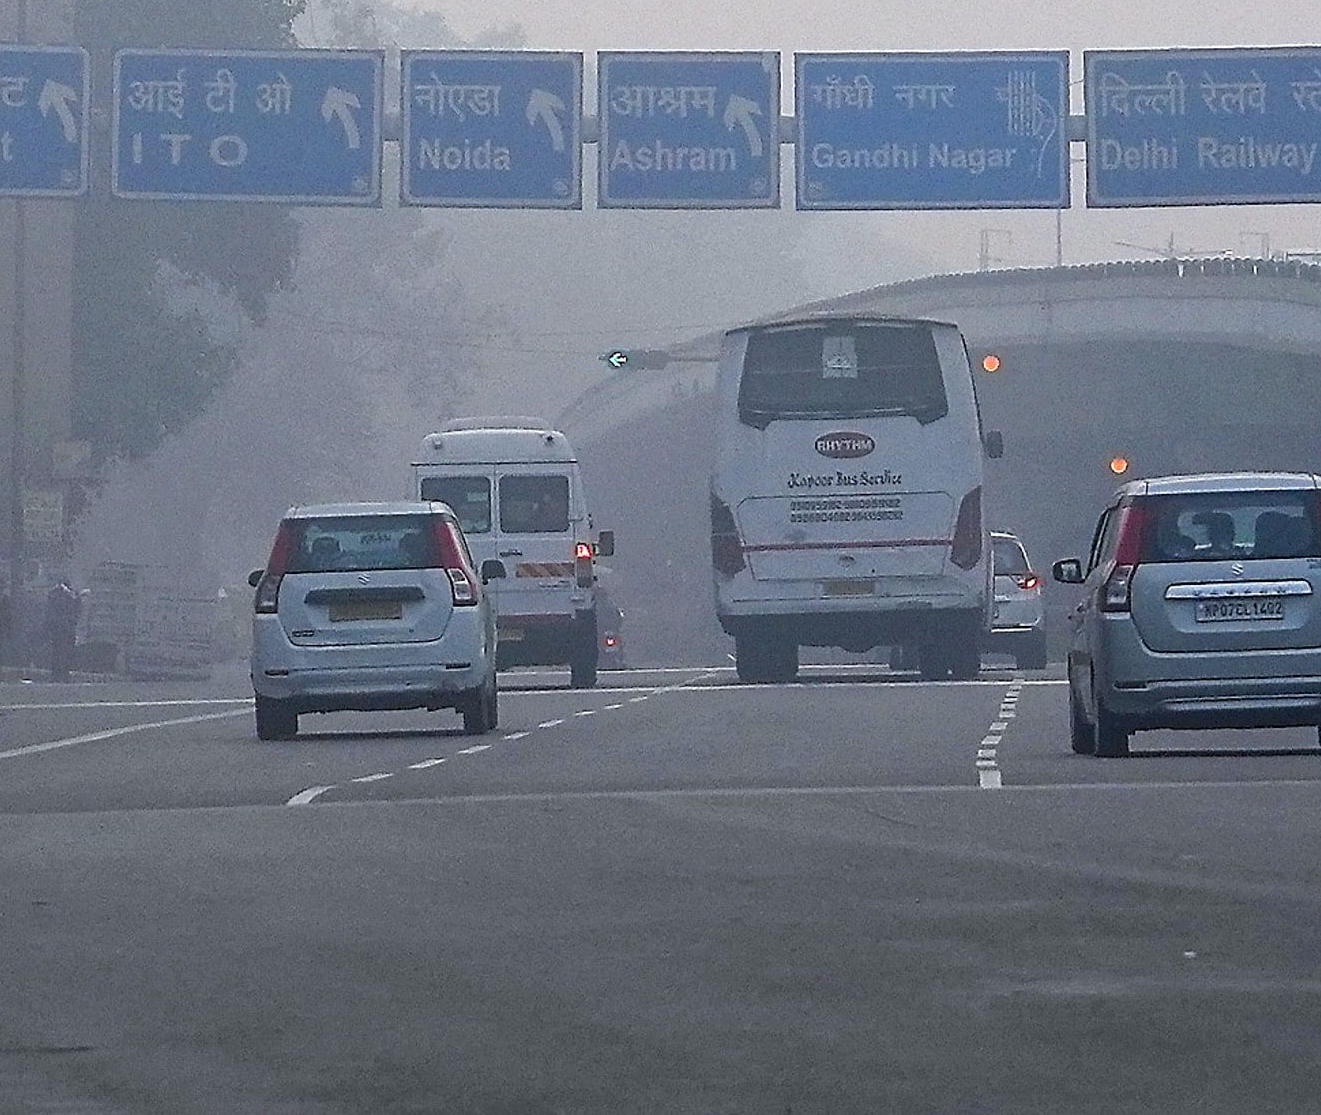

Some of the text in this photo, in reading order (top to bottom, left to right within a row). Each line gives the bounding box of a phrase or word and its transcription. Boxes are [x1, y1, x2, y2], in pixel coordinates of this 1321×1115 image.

[413, 69, 502, 123] नोएडा
[610, 85, 719, 118] आश्रम
[892, 84, 957, 110] नगर
[1098, 70, 1187, 118] दिल्ली
[1200, 68, 1268, 115] रेलवे
[418, 138, 512, 171] Noida
[610, 139, 737, 171] Ashram
[812, 142, 1018, 175] Gandhi Nagar
[1100, 137, 1178, 171] Delhi
[1197, 136, 1319, 176] Railway
[816, 439, 873, 452] RHYTHM
[835, 471, 859, 487] Bus
[859, 468, 903, 487] Service
